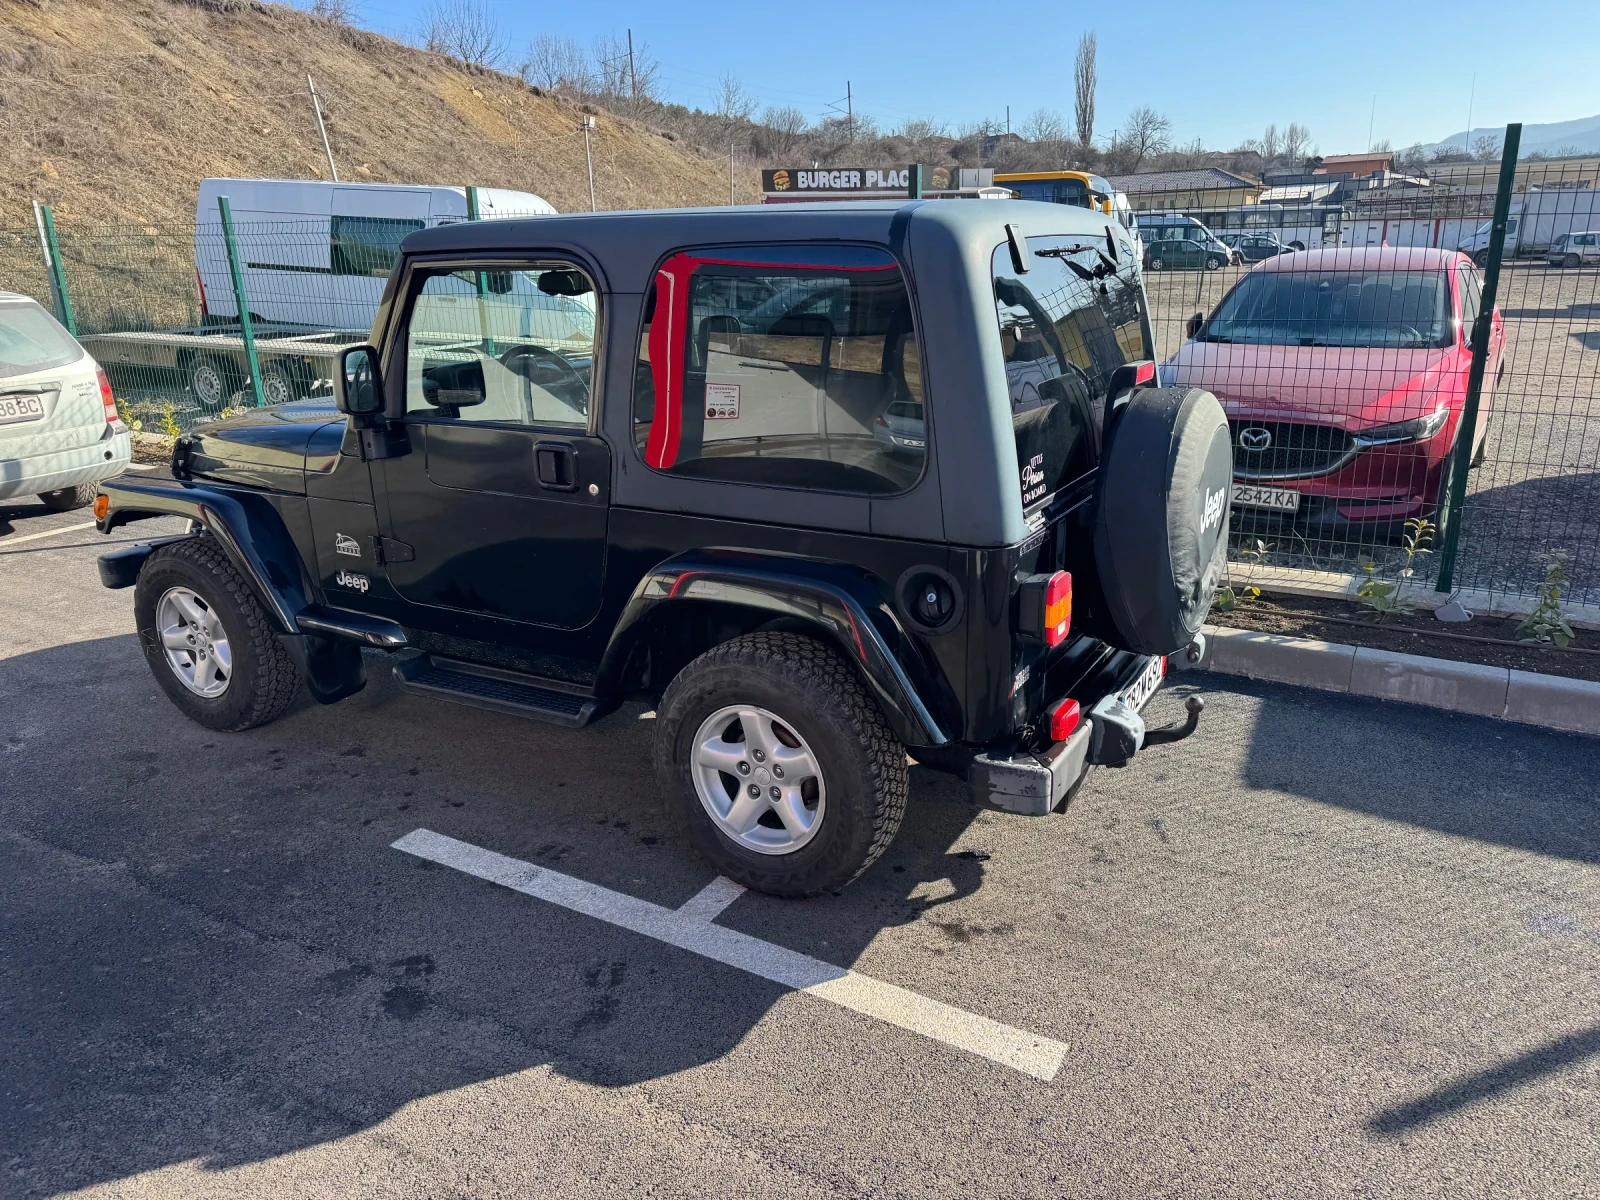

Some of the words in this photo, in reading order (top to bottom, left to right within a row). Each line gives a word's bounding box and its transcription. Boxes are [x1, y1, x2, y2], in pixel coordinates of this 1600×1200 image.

[798, 171, 861, 188] BURGER
[866, 170, 909, 188] PLAC
[1200, 487, 1225, 535] Jeep
[336, 569, 369, 593] Jeep
